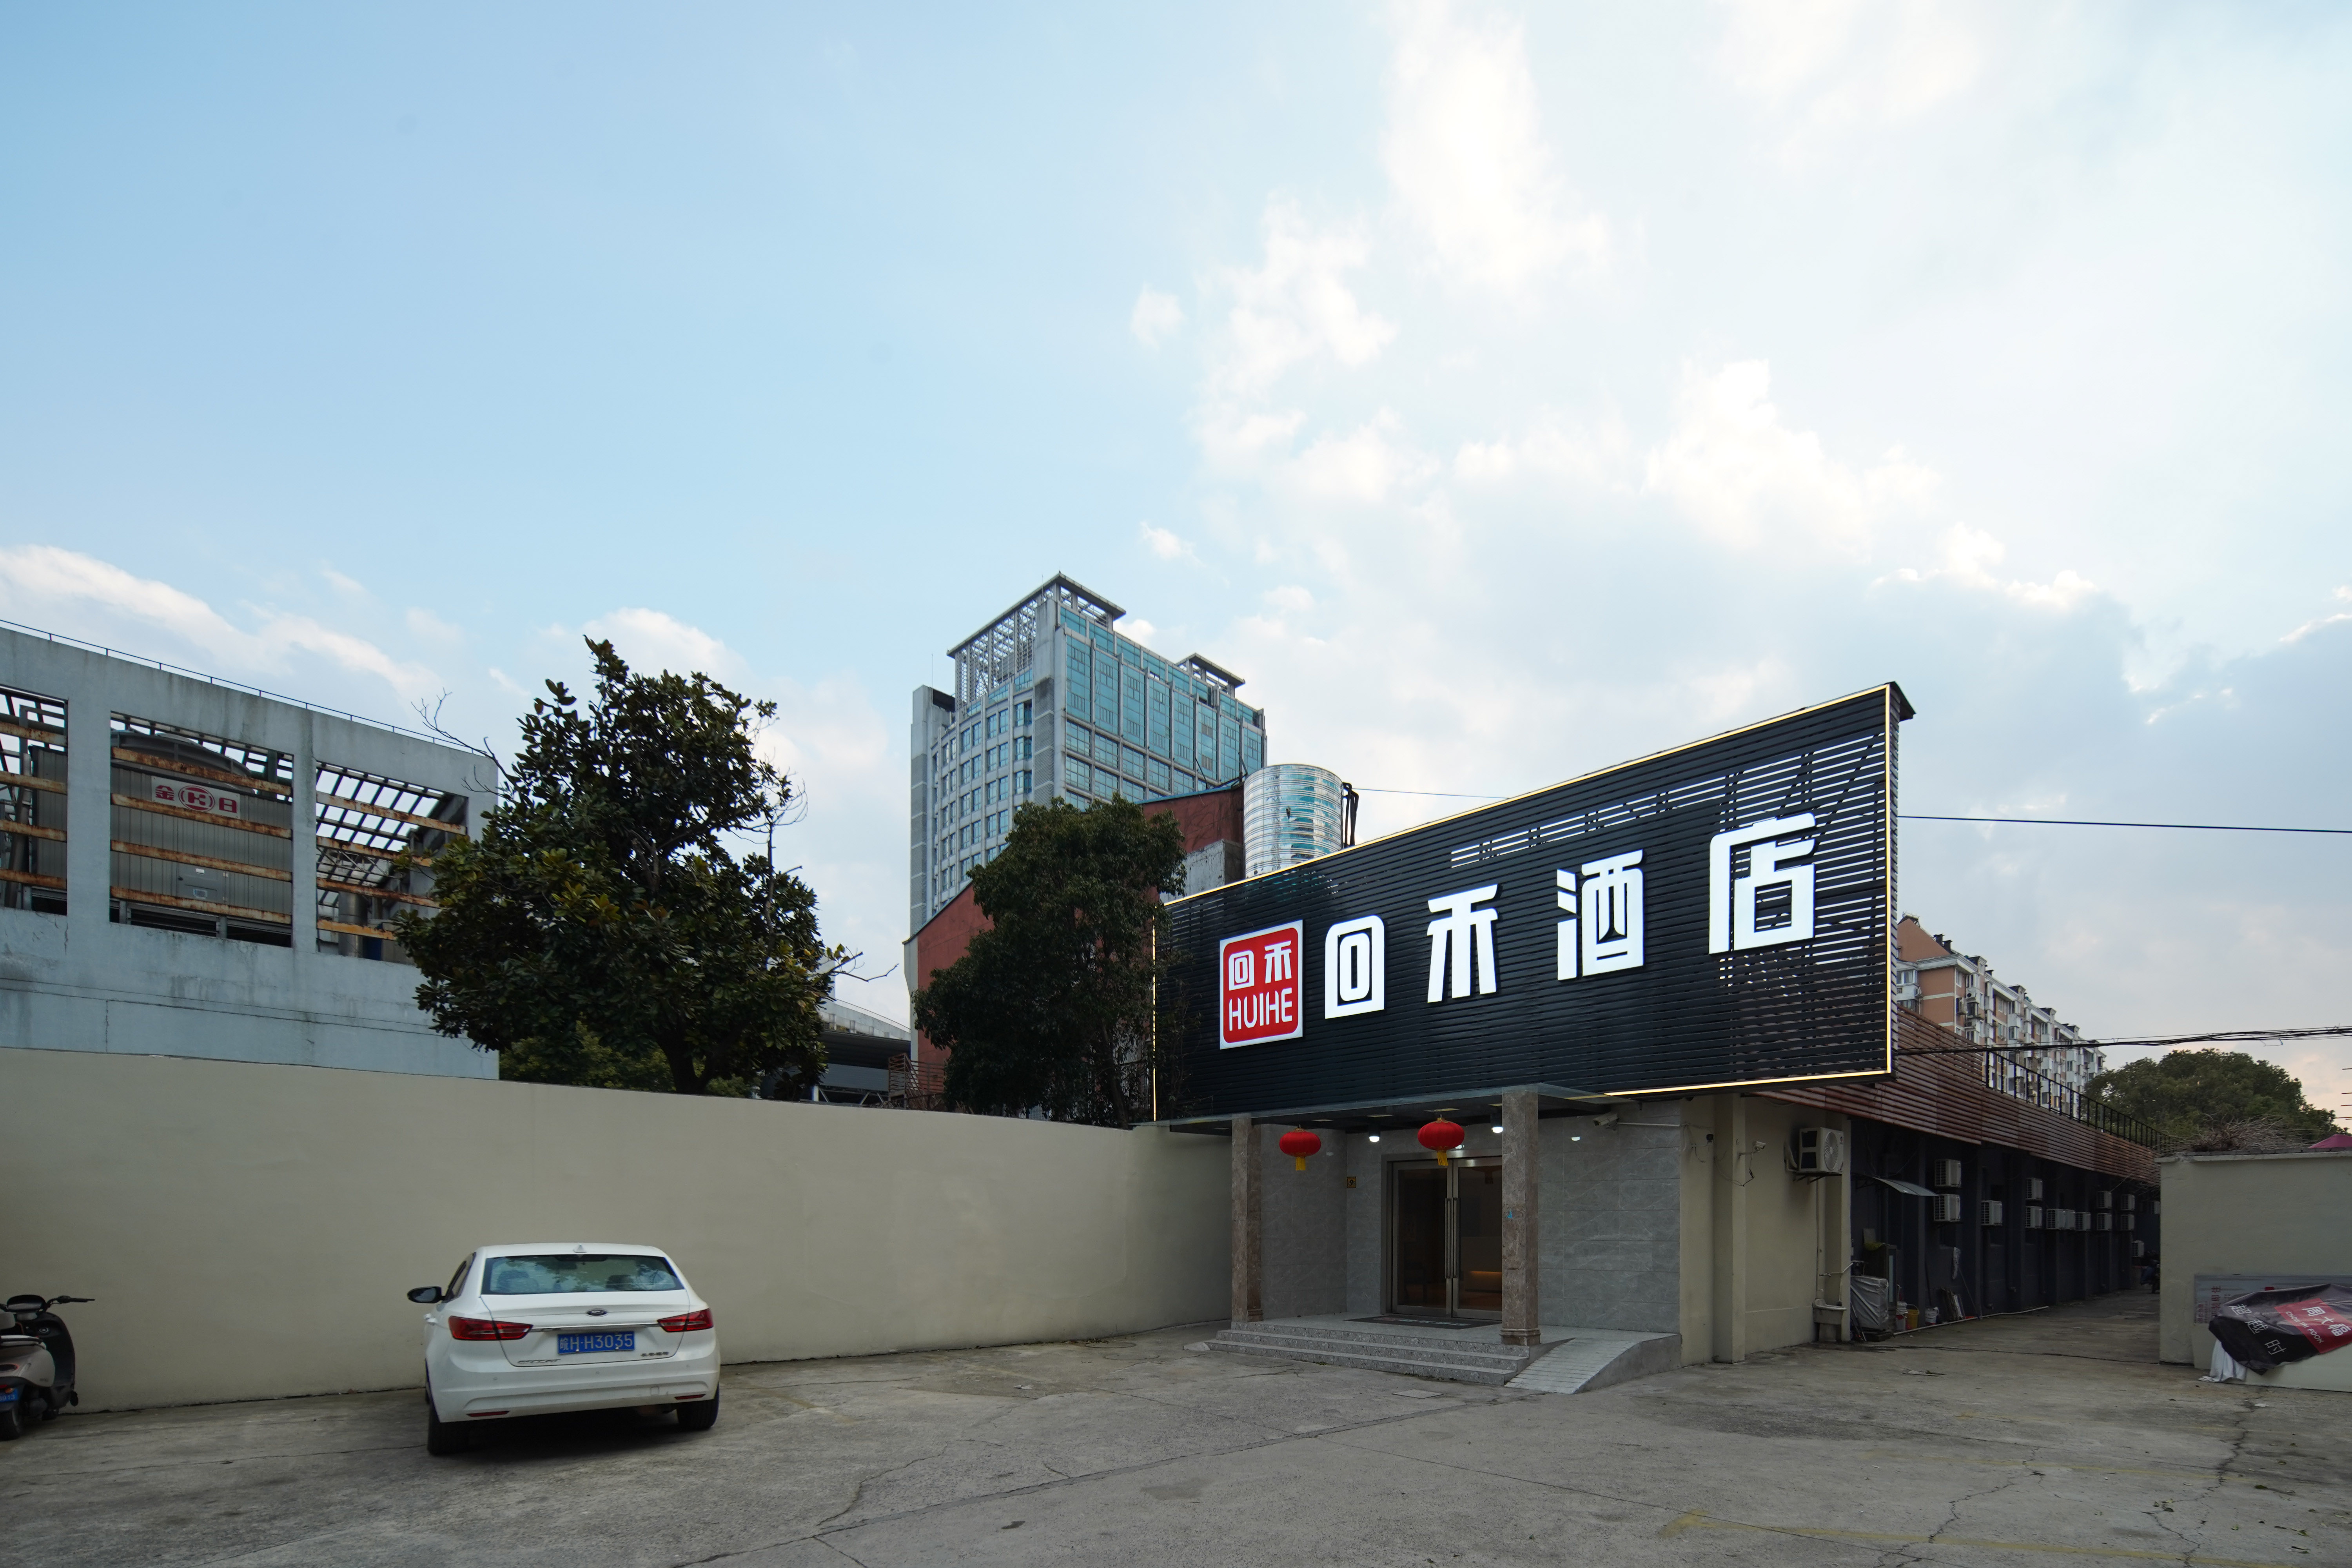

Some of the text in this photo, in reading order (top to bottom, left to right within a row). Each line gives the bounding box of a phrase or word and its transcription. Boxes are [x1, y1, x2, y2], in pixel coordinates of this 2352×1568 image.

[155, 785, 175, 801] 金
[219, 797, 237, 813] 日
[1325, 812, 1816, 1019] 回禾酒店
[1228, 940, 1292, 991] 回禾
[1229, 987, 1293, 1031] HUIHE
[2286, 1311, 2300, 1323] CHOW
[2307, 1328, 2325, 1344] FOOK
[2301, 1306, 2352, 1337] 周大福
